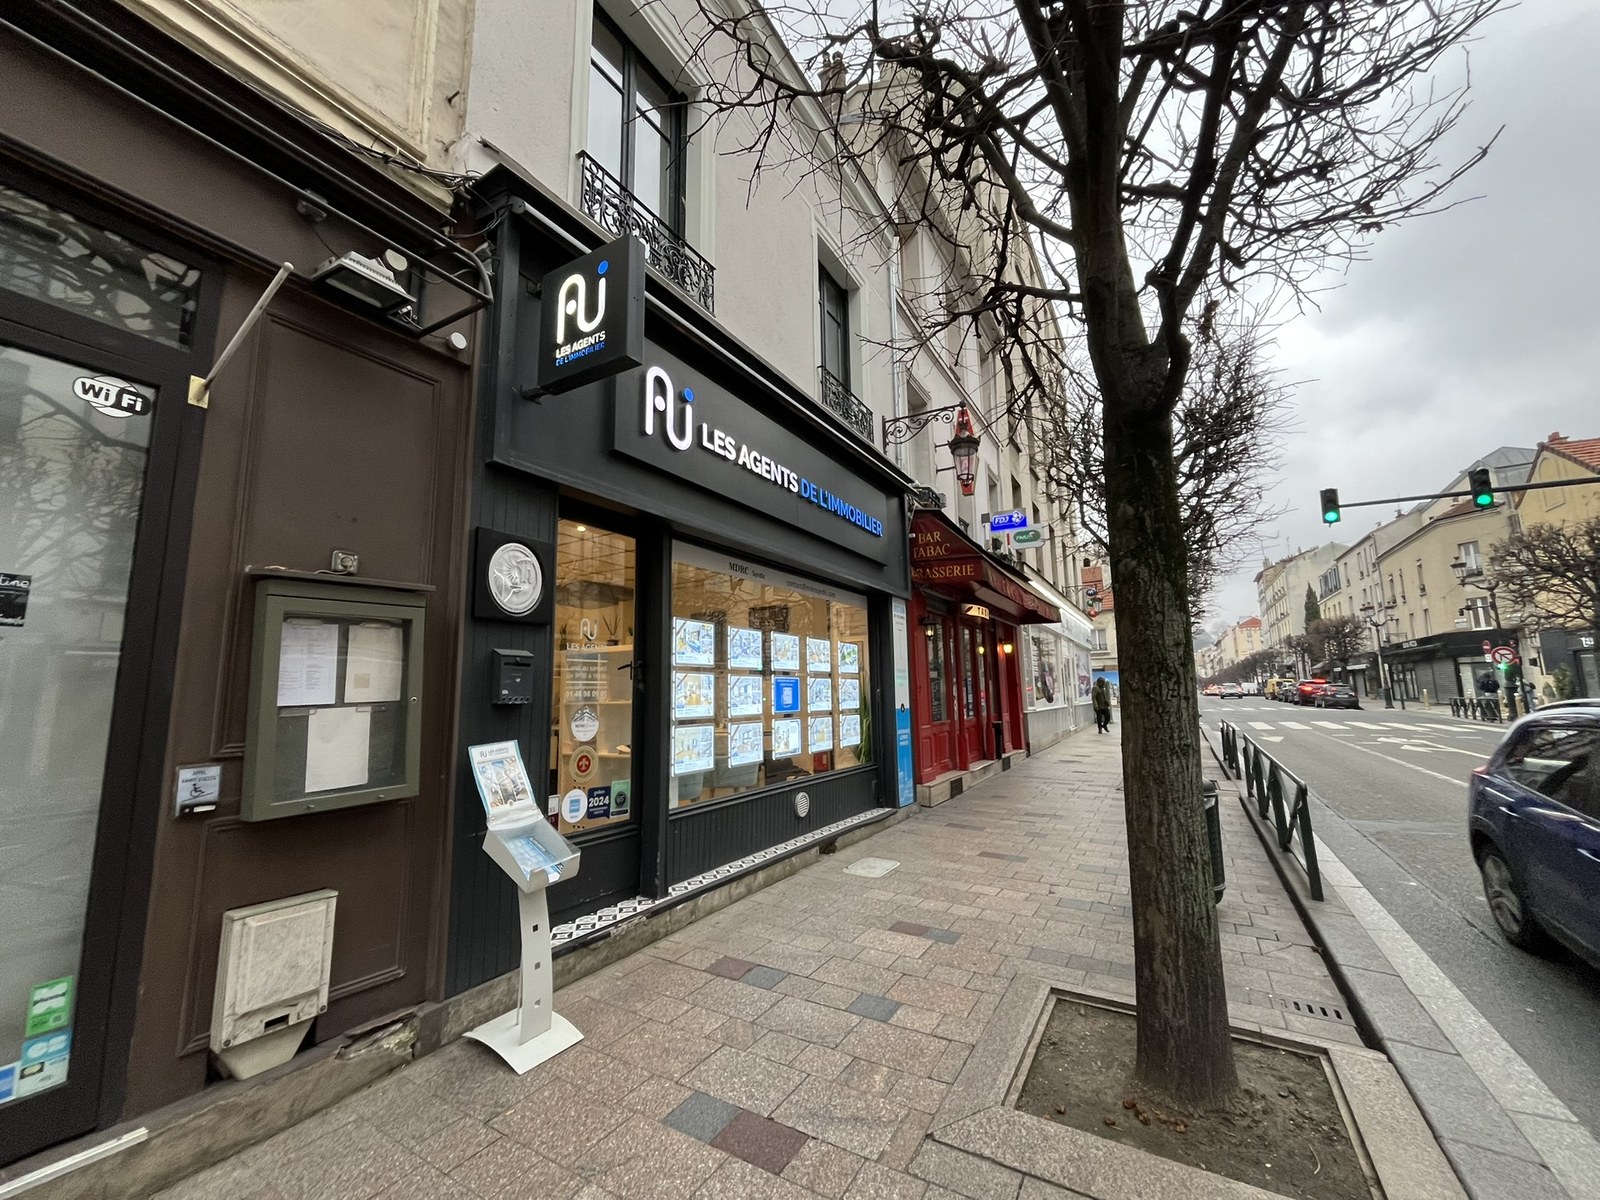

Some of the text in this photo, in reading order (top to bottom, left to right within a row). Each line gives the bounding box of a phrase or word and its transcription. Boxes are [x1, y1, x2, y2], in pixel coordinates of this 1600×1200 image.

[555, 330, 606, 358] LES AGENTS
[702, 423, 884, 538] LES AGENTS DE L'IMMOBILIER
[994, 516, 1010, 525] FDJ
[918, 530, 942, 544] BAR
[728, 561, 749, 576] MDRC
[566, 642, 580, 651] LES
[588, 796, 610, 808] 2024
